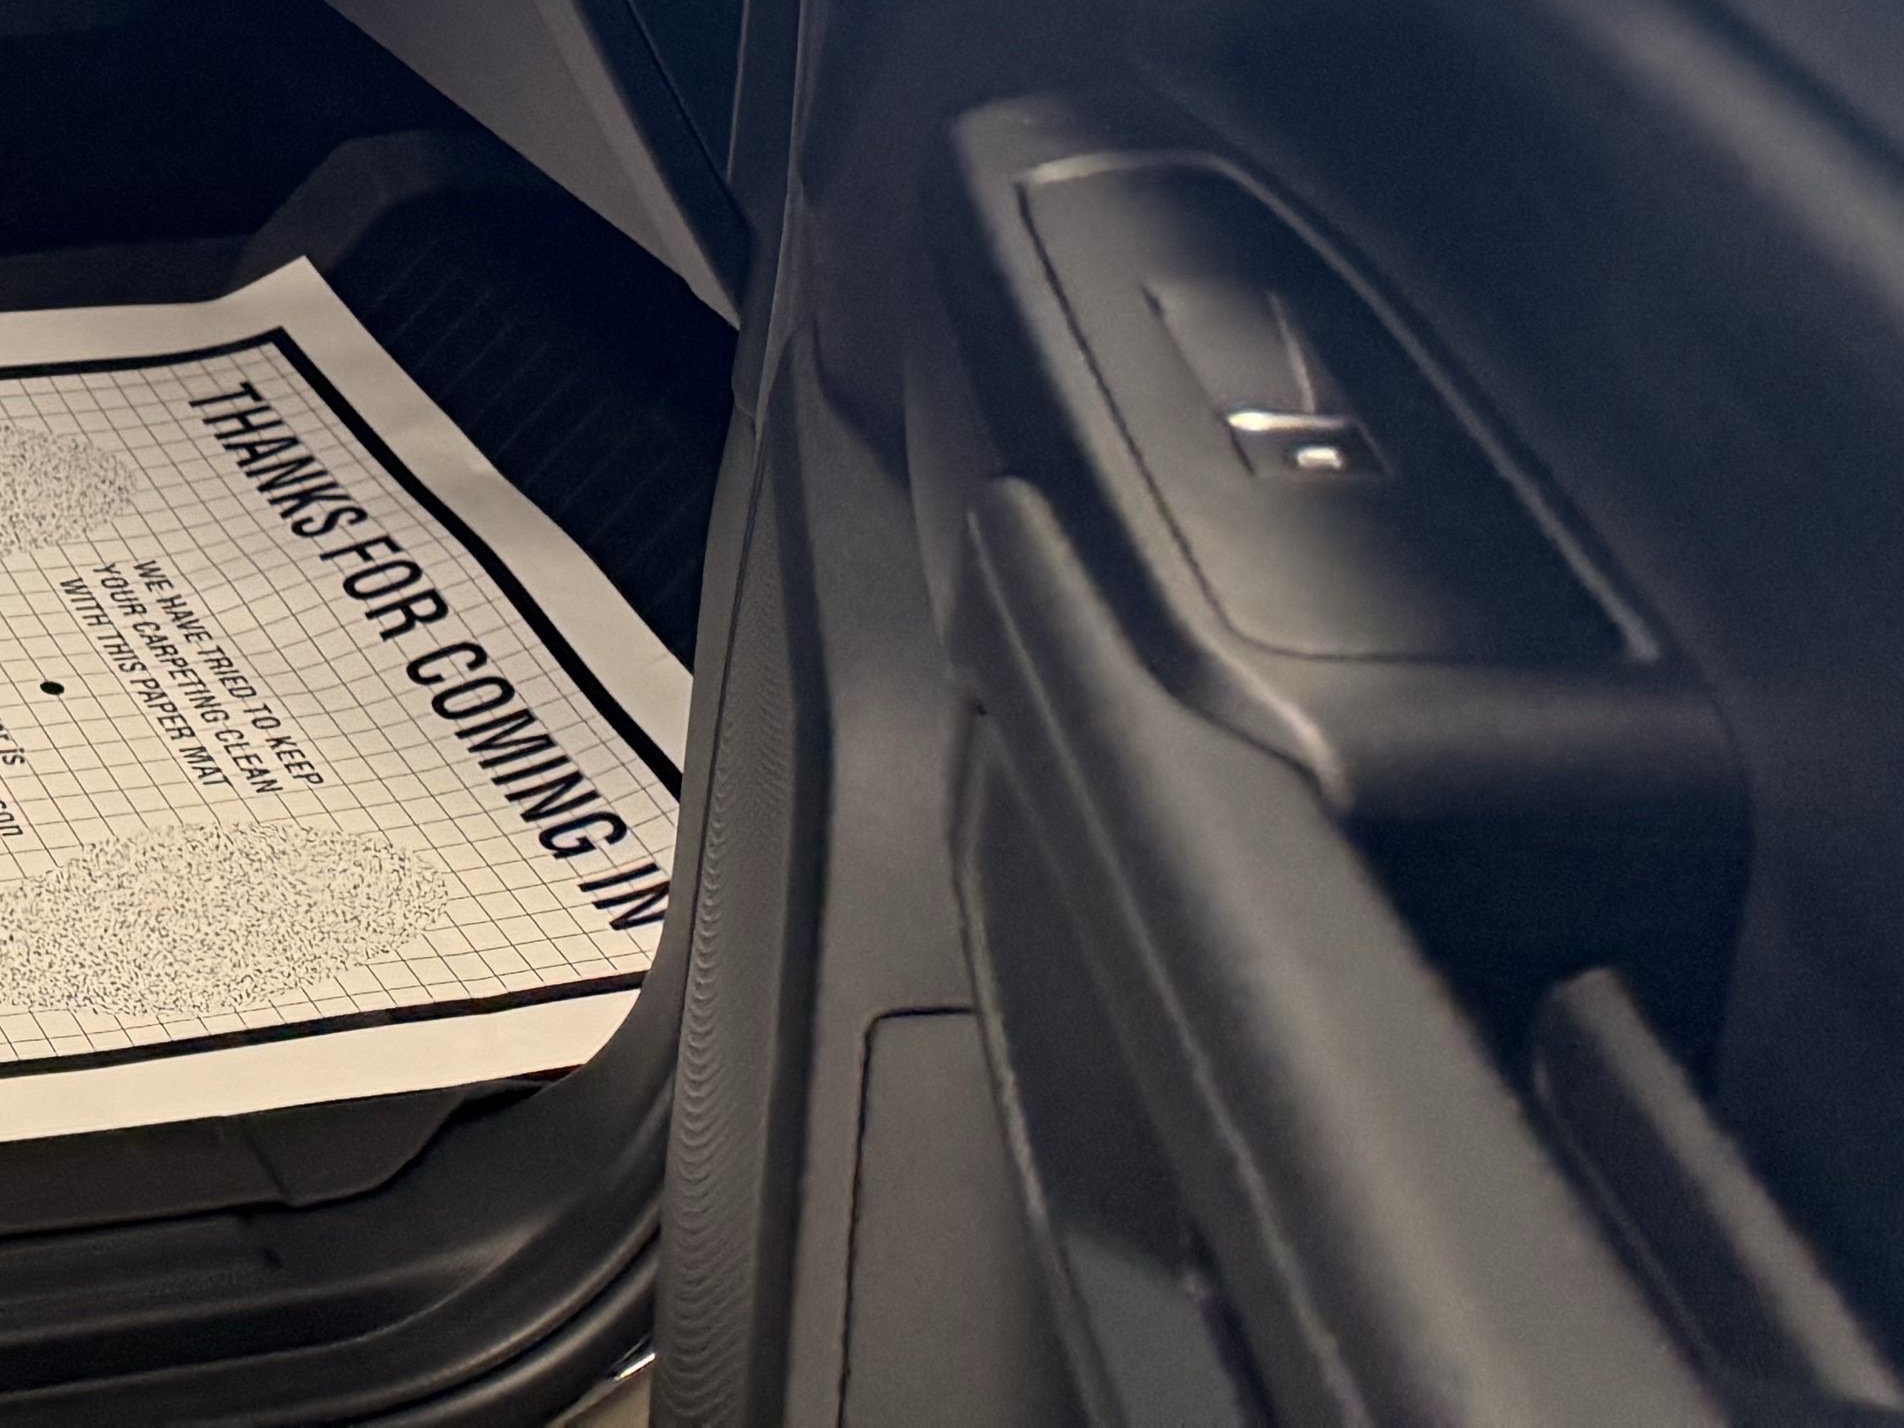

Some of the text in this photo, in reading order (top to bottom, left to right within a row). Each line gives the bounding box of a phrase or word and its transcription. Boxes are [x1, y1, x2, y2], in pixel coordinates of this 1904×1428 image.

[60, 577, 234, 787] WITH THIS PAPER MAT
[93, 562, 283, 794] YOUR CARPETING CLEAN
[133, 560, 324, 785] WE HAVE TRIED TO KEEP
[188, 381, 670, 931] THANKS FOR COMING IN
